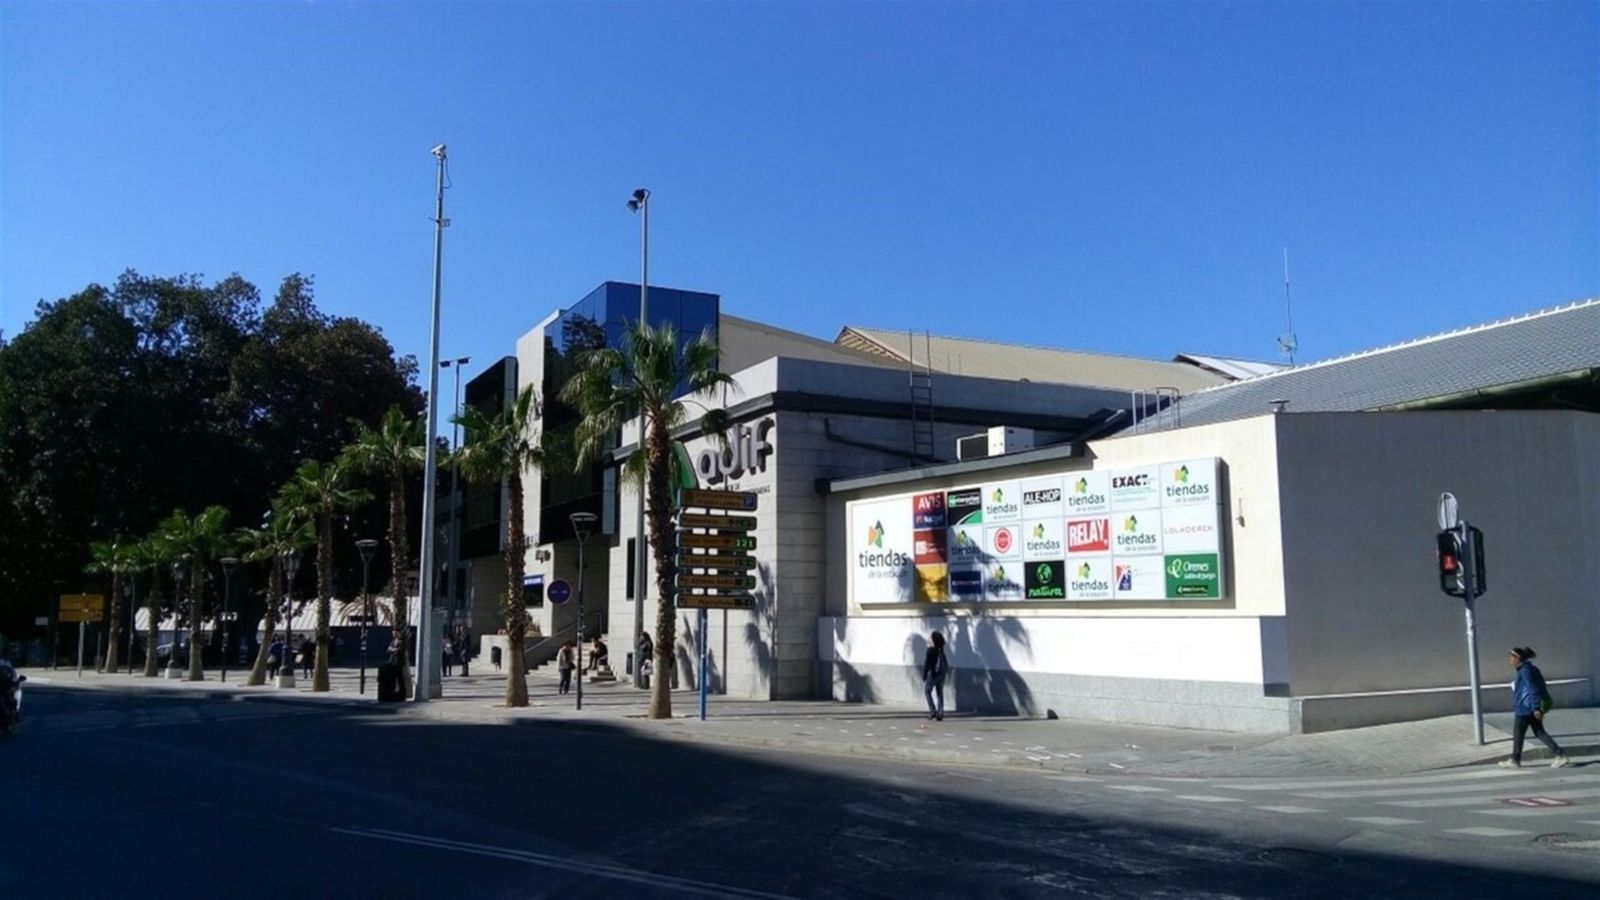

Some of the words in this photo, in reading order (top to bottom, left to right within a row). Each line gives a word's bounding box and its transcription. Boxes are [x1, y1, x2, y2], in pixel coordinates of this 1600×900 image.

[697, 419, 773, 484] adif
[1166, 483, 1209, 497] tiendas
[918, 495, 941, 511] AVIS
[1024, 489, 1060, 505] ALE-HOP
[1069, 493, 1105, 506] tiendas
[986, 502, 1018, 515] tiendas
[1117, 532, 1156, 545] tiendas
[1027, 540, 1060, 551] tiendas
[859, 549, 908, 568] tiendas
[1028, 586, 1063, 597] natura
[1071, 579, 1108, 591] tiendas
